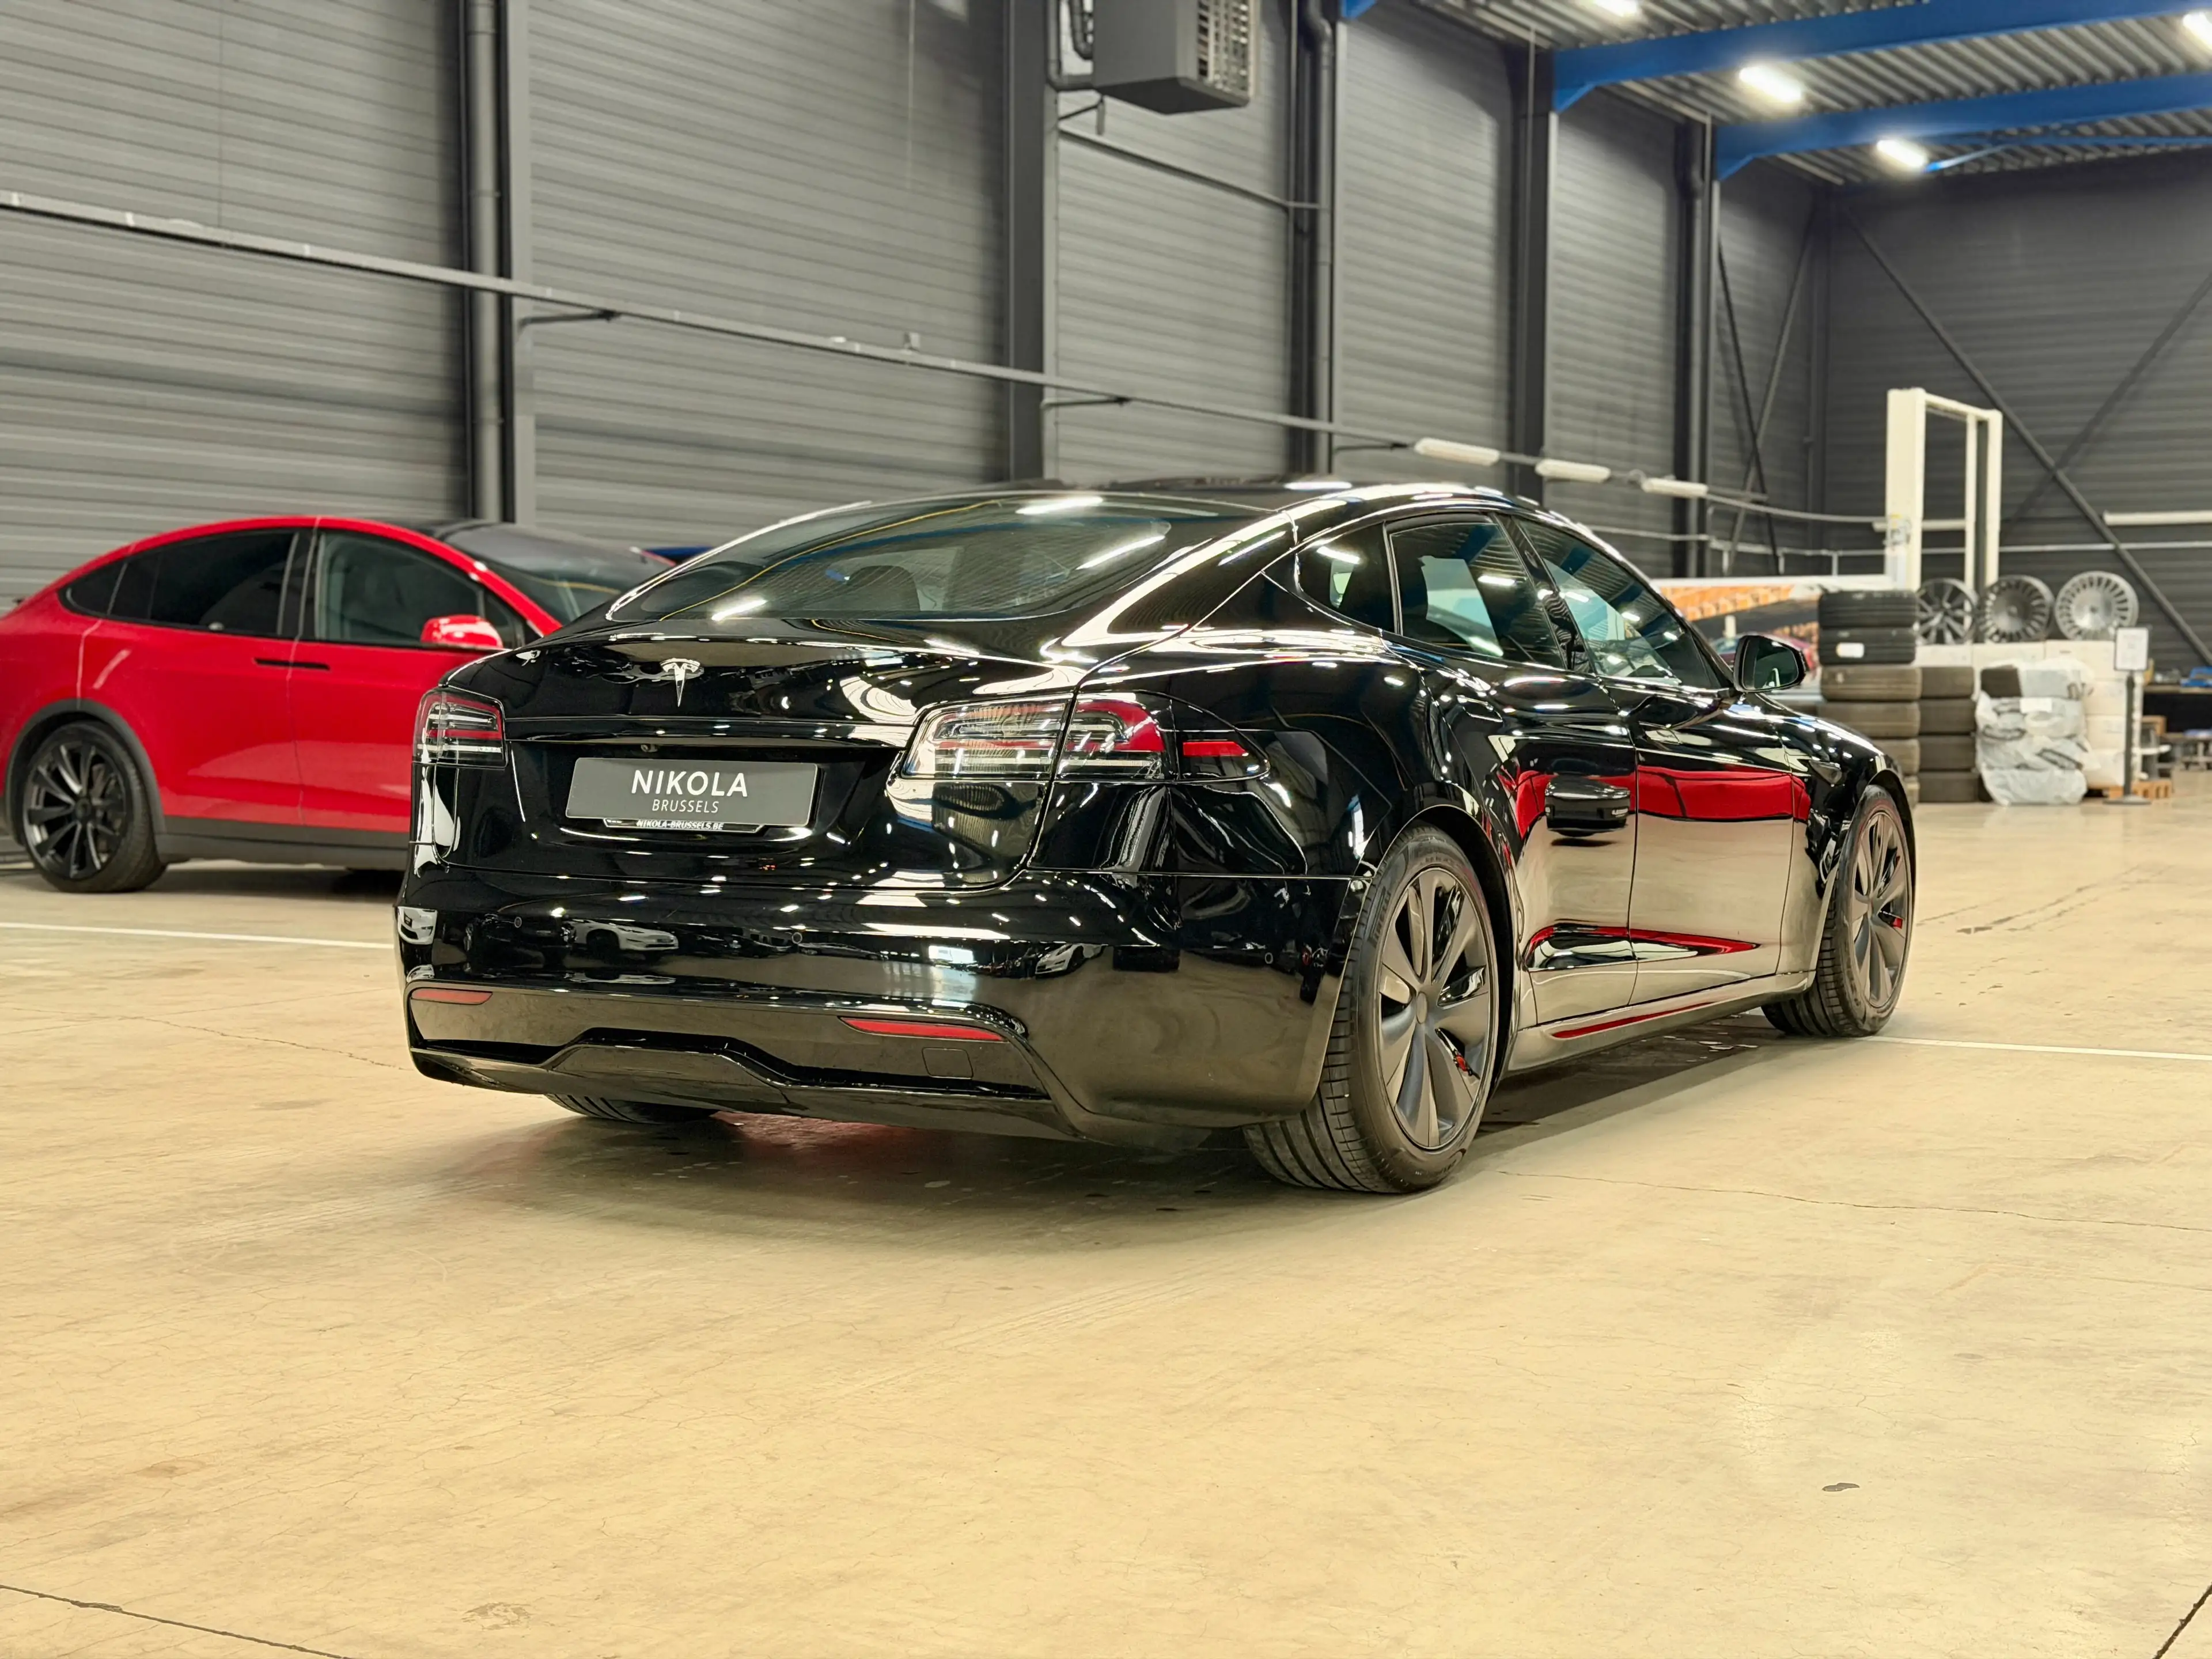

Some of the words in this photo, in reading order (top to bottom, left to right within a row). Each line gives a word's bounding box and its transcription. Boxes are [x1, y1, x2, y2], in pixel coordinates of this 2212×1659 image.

[631, 770, 748, 797] NIKOLA
[652, 799, 719, 814] BRUSSELS
[635, 819, 725, 831] NIKOLA-BRUSSELS.BE
